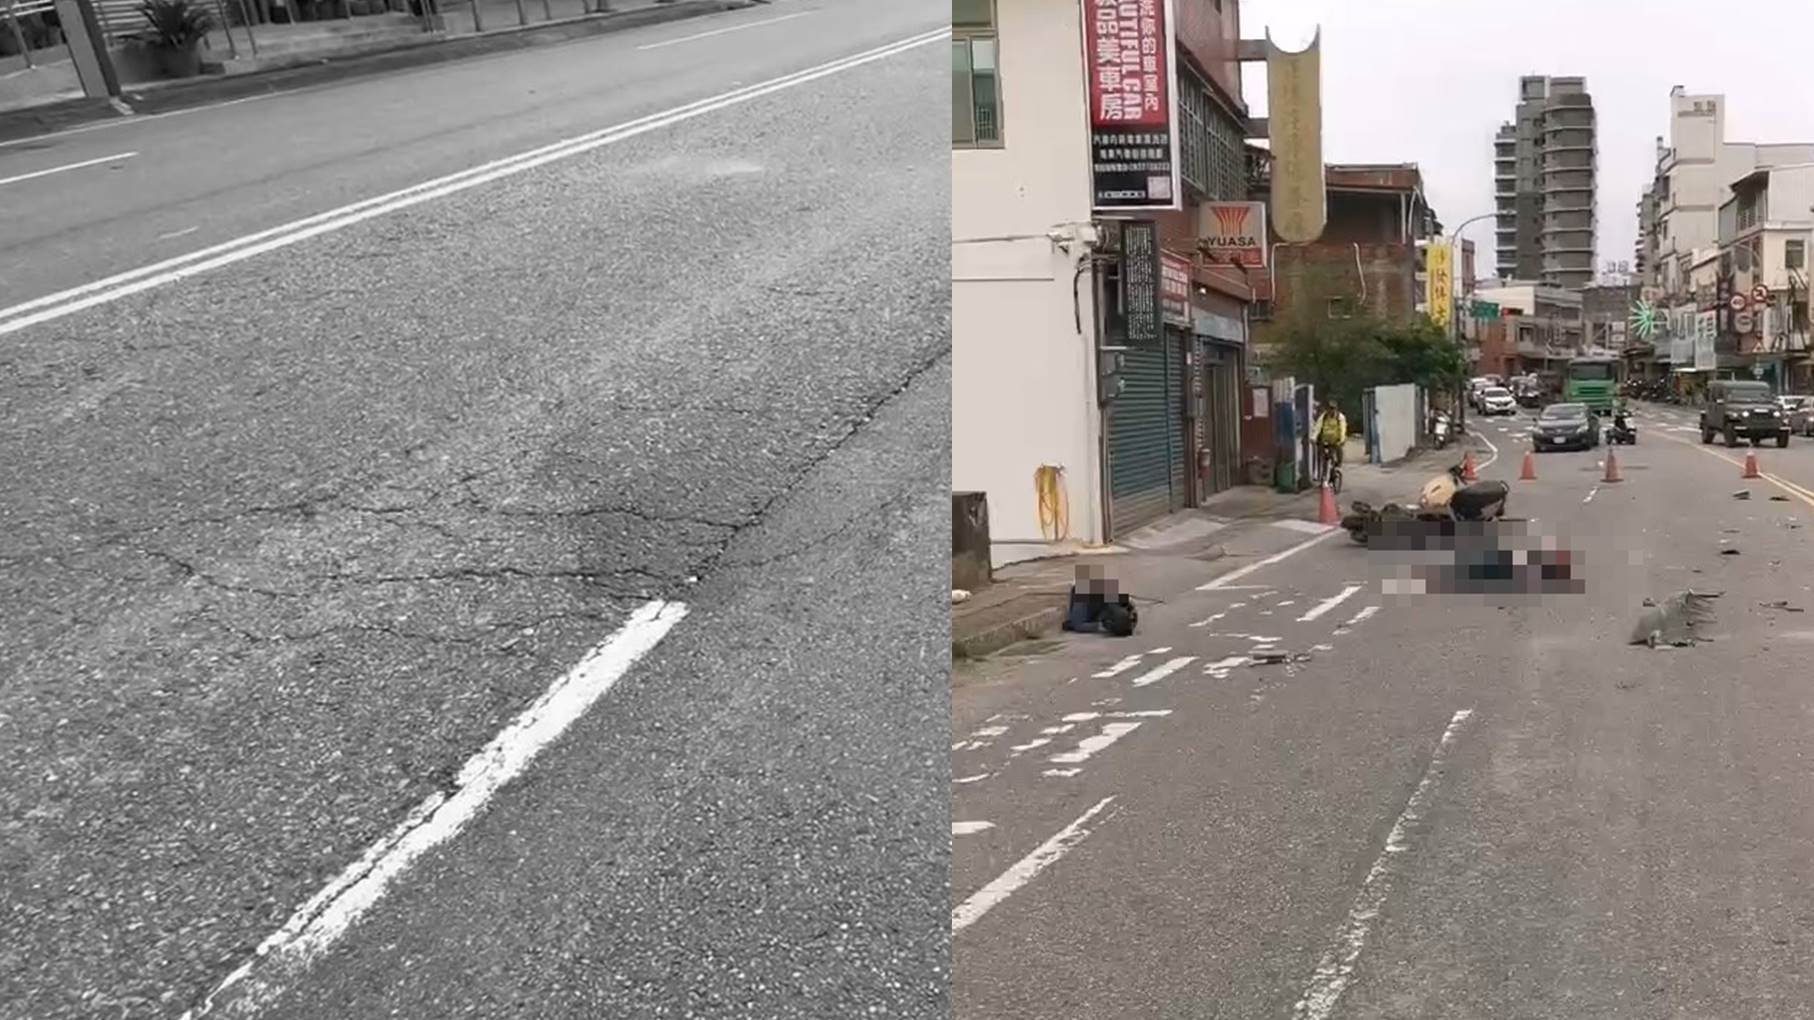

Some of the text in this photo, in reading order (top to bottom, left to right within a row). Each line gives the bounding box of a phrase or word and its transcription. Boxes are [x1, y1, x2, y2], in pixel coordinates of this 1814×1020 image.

[1095, 0, 1123, 120] 品美車房
[1117, 0, 1142, 119] UTIFUL CAR
[1207, 236, 1256, 247] YUASA
